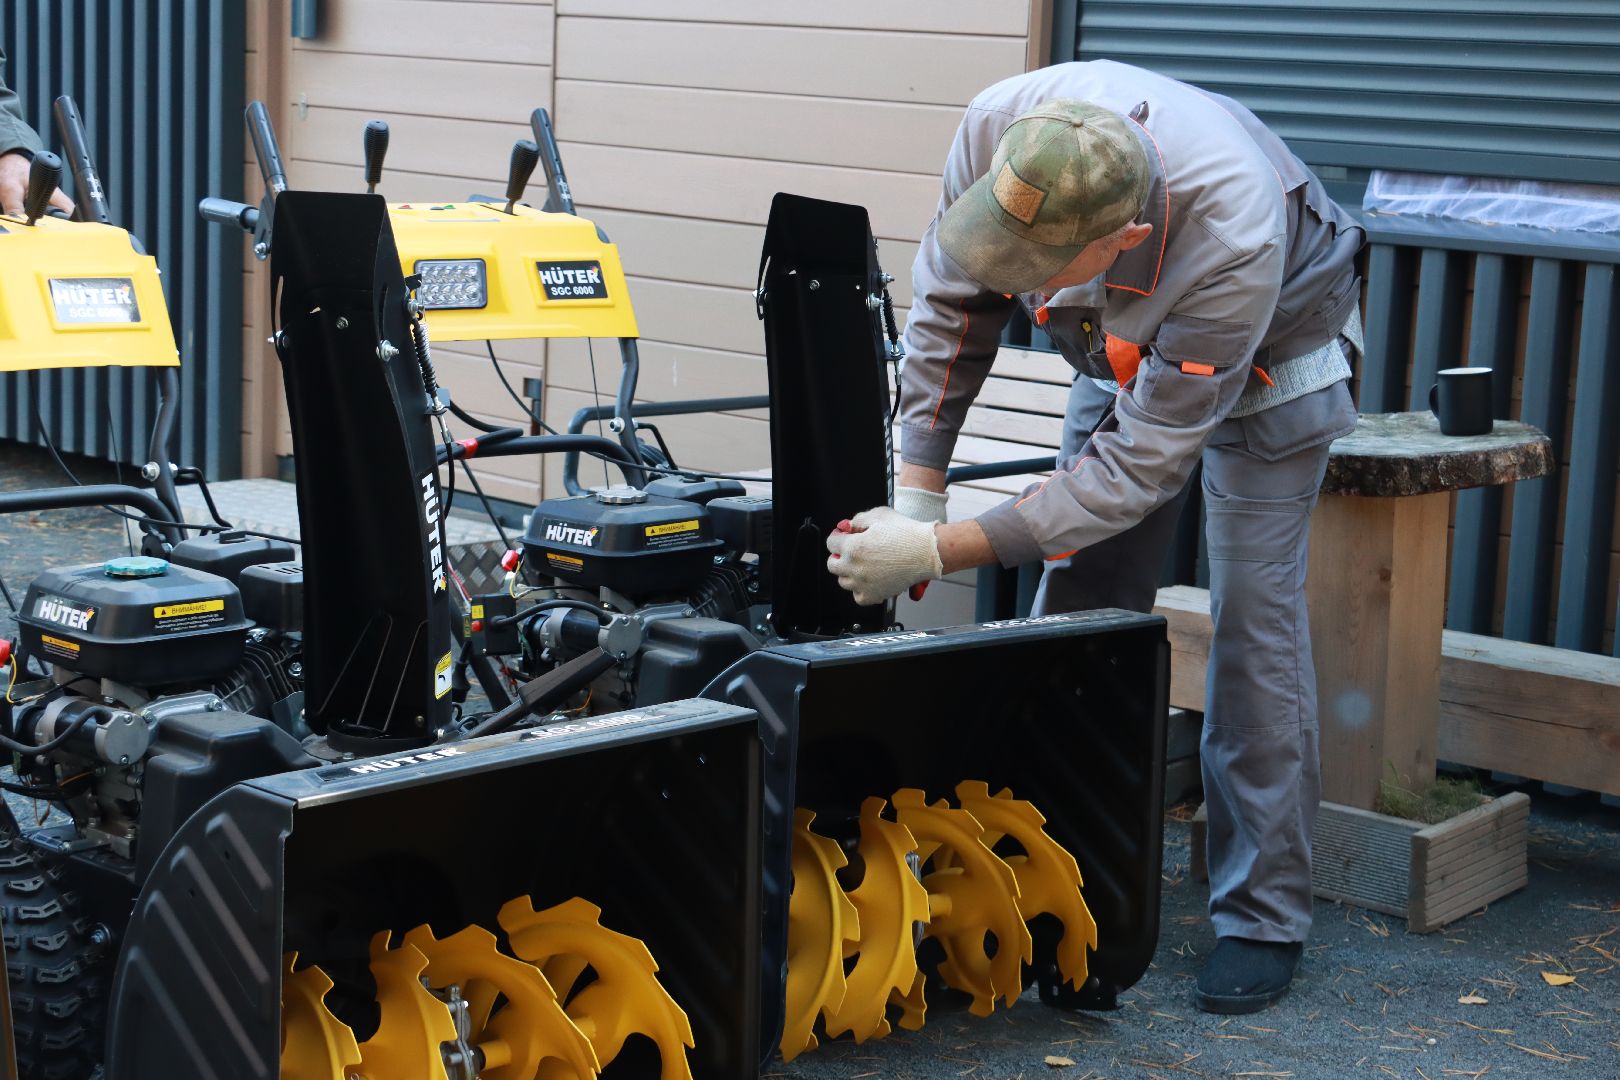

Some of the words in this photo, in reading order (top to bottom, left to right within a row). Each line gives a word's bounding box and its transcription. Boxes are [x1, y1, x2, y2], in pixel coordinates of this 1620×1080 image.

[540, 267, 600, 285] HÜTER
[53, 285, 131, 304] HÜTER
[552, 287, 571, 296] SGC
[573, 286, 593, 296] 6000
[421, 472, 446, 594] HÜTER
[546, 523, 594, 547] HÜTER
[39, 599, 90, 631] HÜTER
[350, 747, 466, 774] HÜTER
